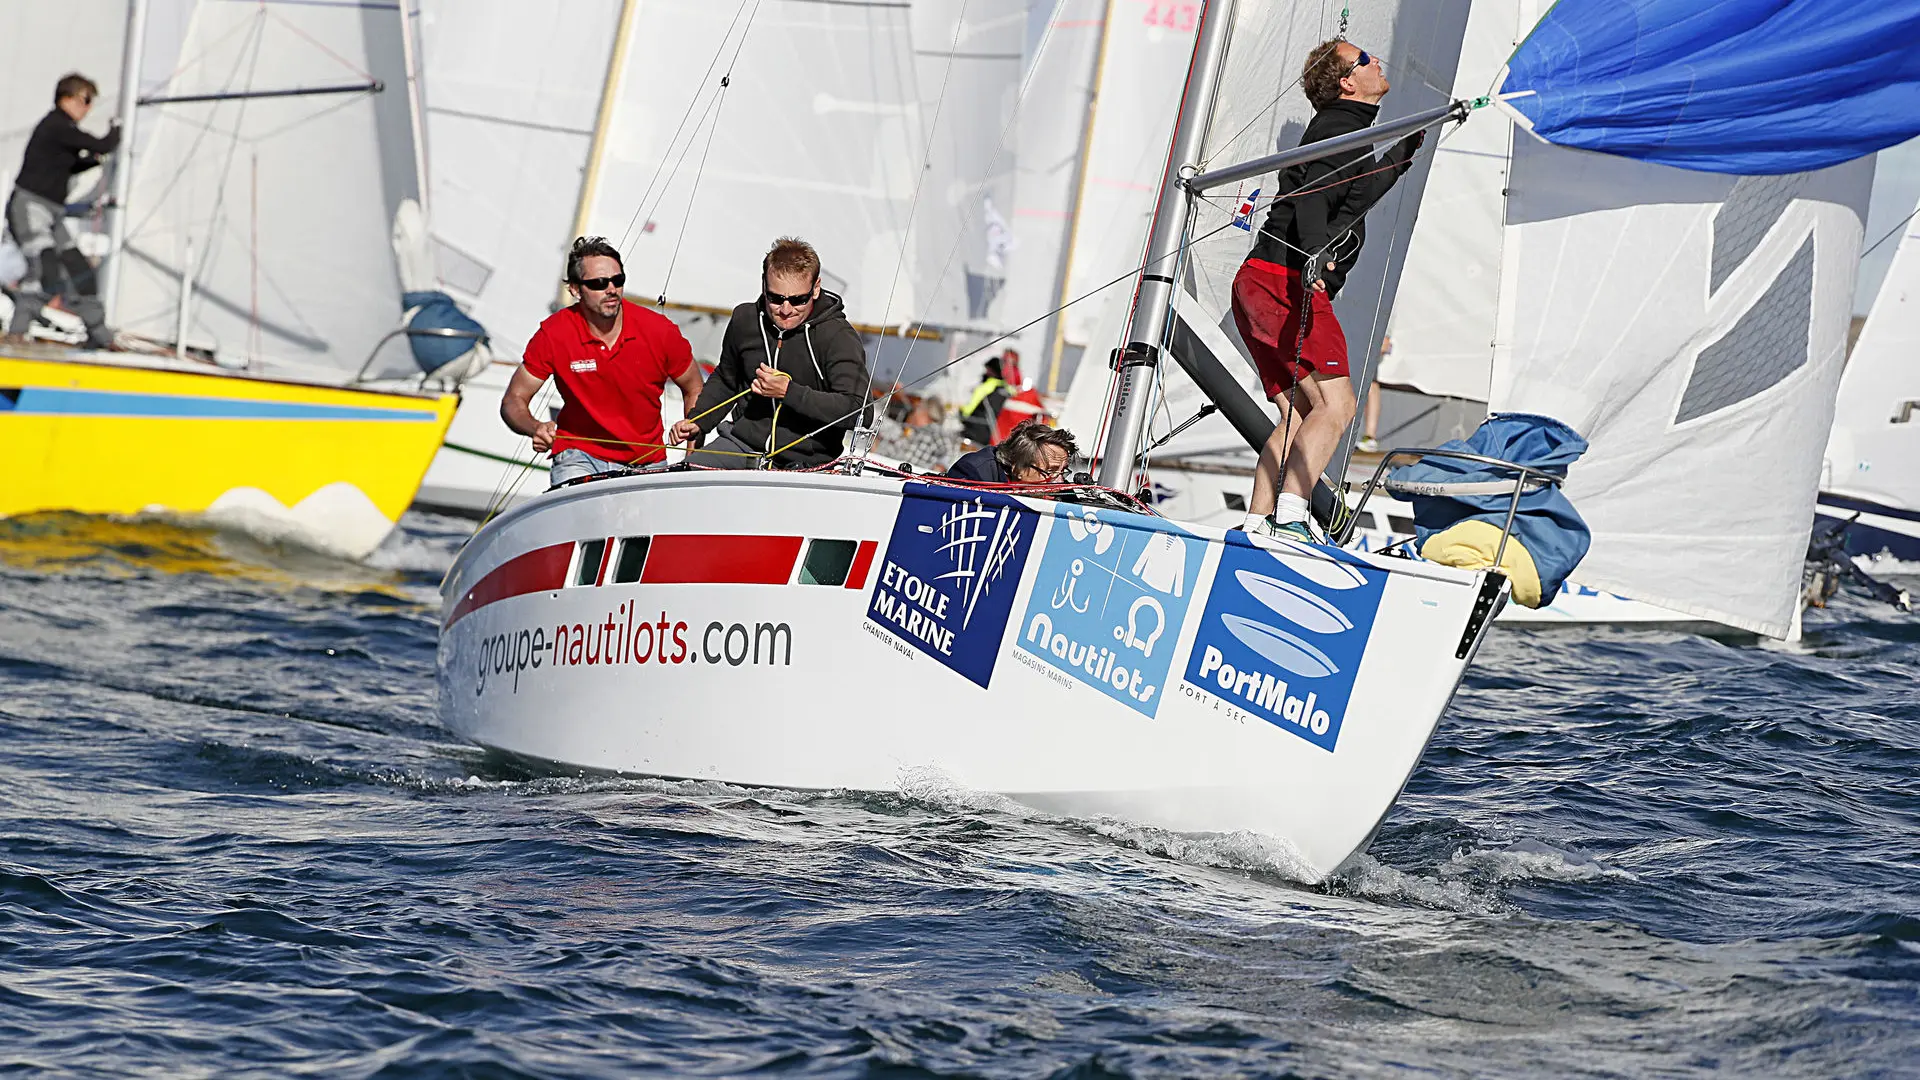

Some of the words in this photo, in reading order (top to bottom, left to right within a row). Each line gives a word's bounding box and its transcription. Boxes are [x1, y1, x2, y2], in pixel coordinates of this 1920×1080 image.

[882, 560, 950, 620] ETOILE
[476, 599, 793, 697] groupe-nautilots.com
[862, 621, 893, 647] CHANTIER
[893, 641, 915, 661] NAVAL
[873, 588, 956, 657] MARINE
[1012, 650, 1047, 676] MAGASINS
[1046, 669, 1074, 690] MARINS
[1199, 644, 1331, 736] PortMalo
[1179, 683, 1208, 705] PORT
[1226, 707, 1247, 725] SEC
